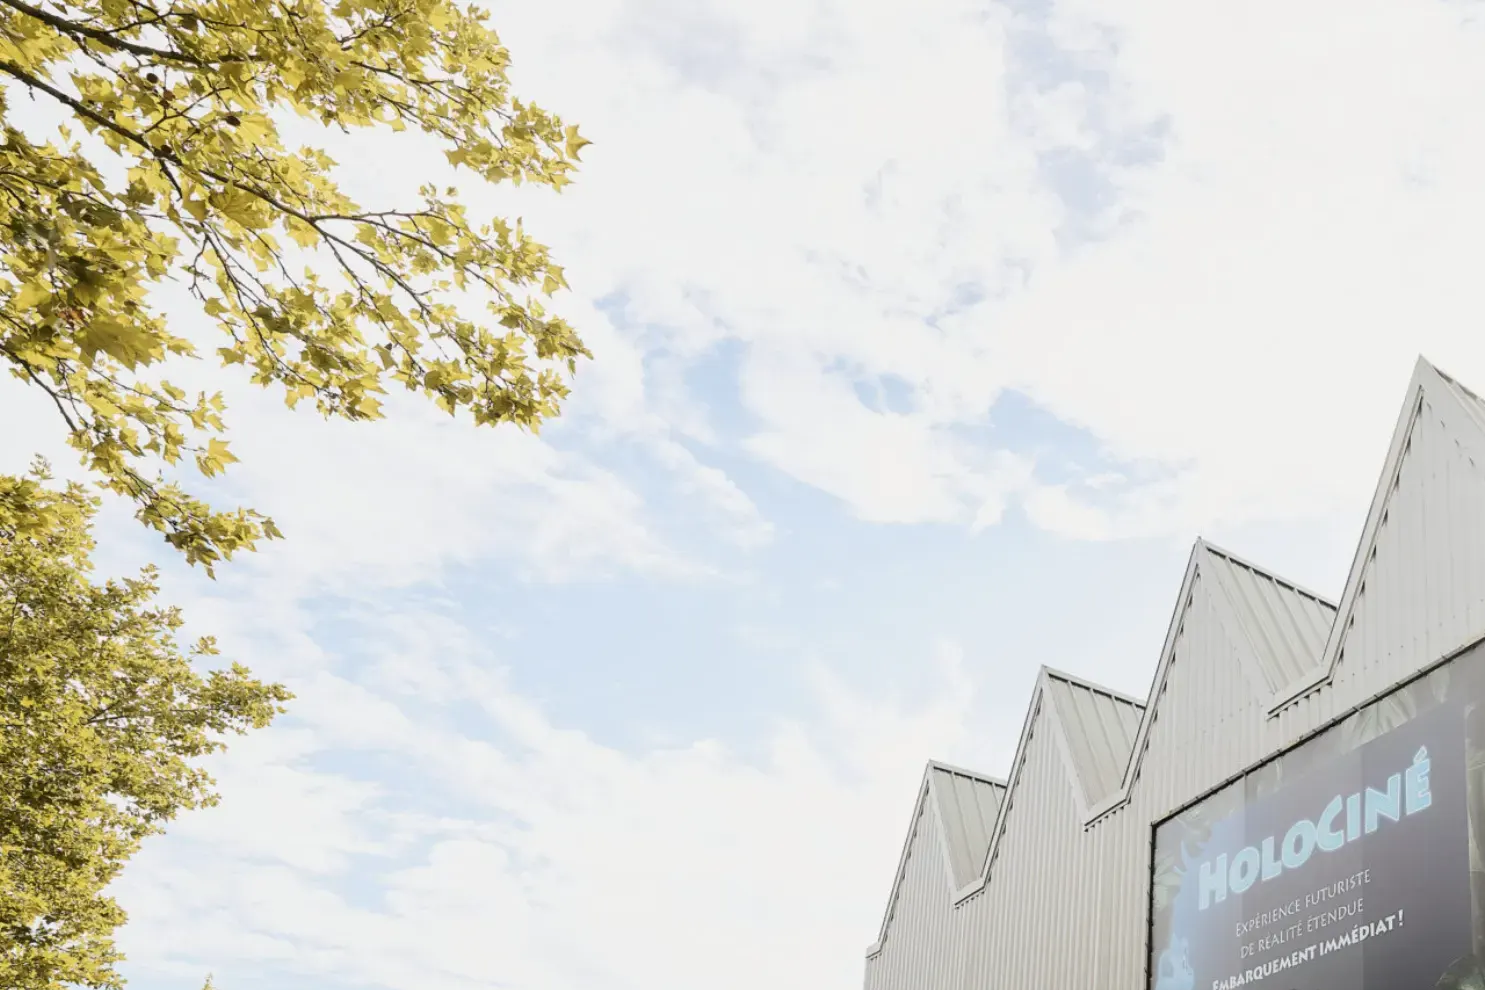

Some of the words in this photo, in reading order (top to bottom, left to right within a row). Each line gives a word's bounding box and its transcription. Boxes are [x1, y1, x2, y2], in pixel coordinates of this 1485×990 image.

[1236, 899, 1301, 937] EXPÉRIENCE
[1305, 869, 1371, 908] FUTURISTE
[1240, 944, 1255, 959] DE
[1258, 921, 1303, 953] RÉALITÉ
[1307, 898, 1364, 932] ÉTENDUE
